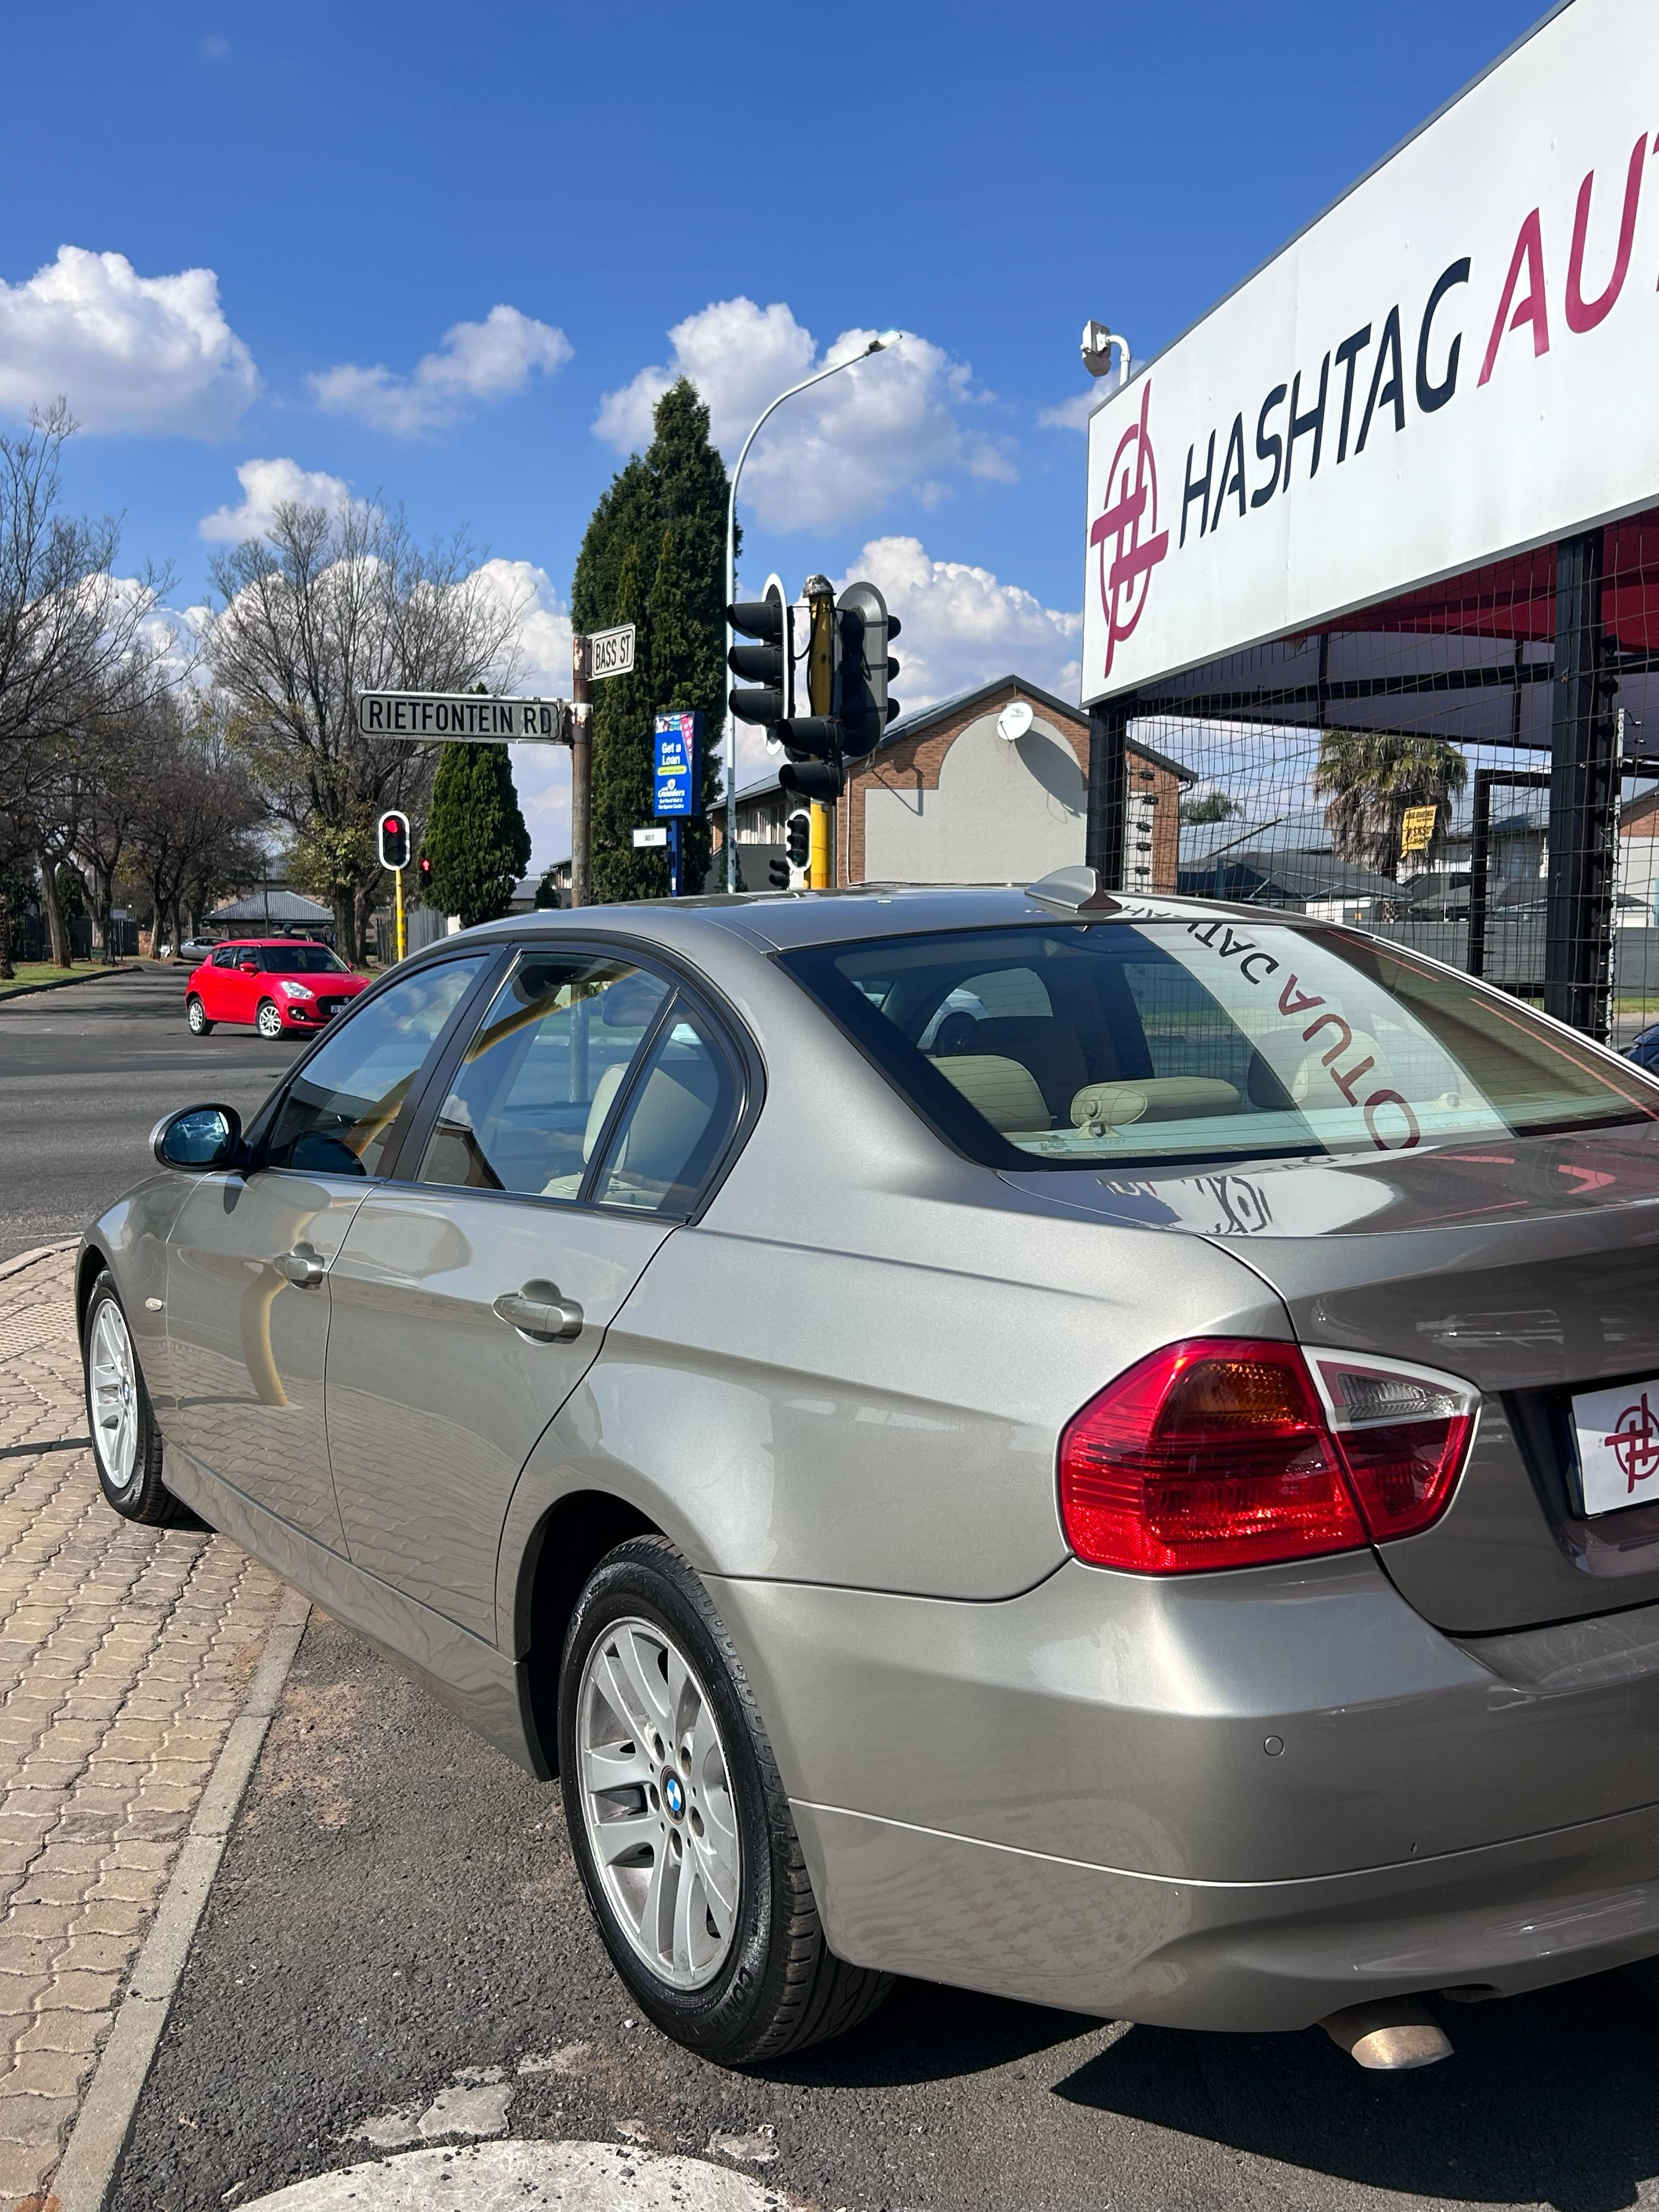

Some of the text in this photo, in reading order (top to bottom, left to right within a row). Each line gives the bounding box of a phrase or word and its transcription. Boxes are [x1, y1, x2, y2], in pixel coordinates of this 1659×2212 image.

[1179, 129, 1659, 550] HASHTAG AU
[596, 634, 631, 670] BASS ST
[369, 700, 552, 734] RIETFONTEIN RD
[662, 742, 681, 754] Get a
[662, 754, 680, 766] Loan
